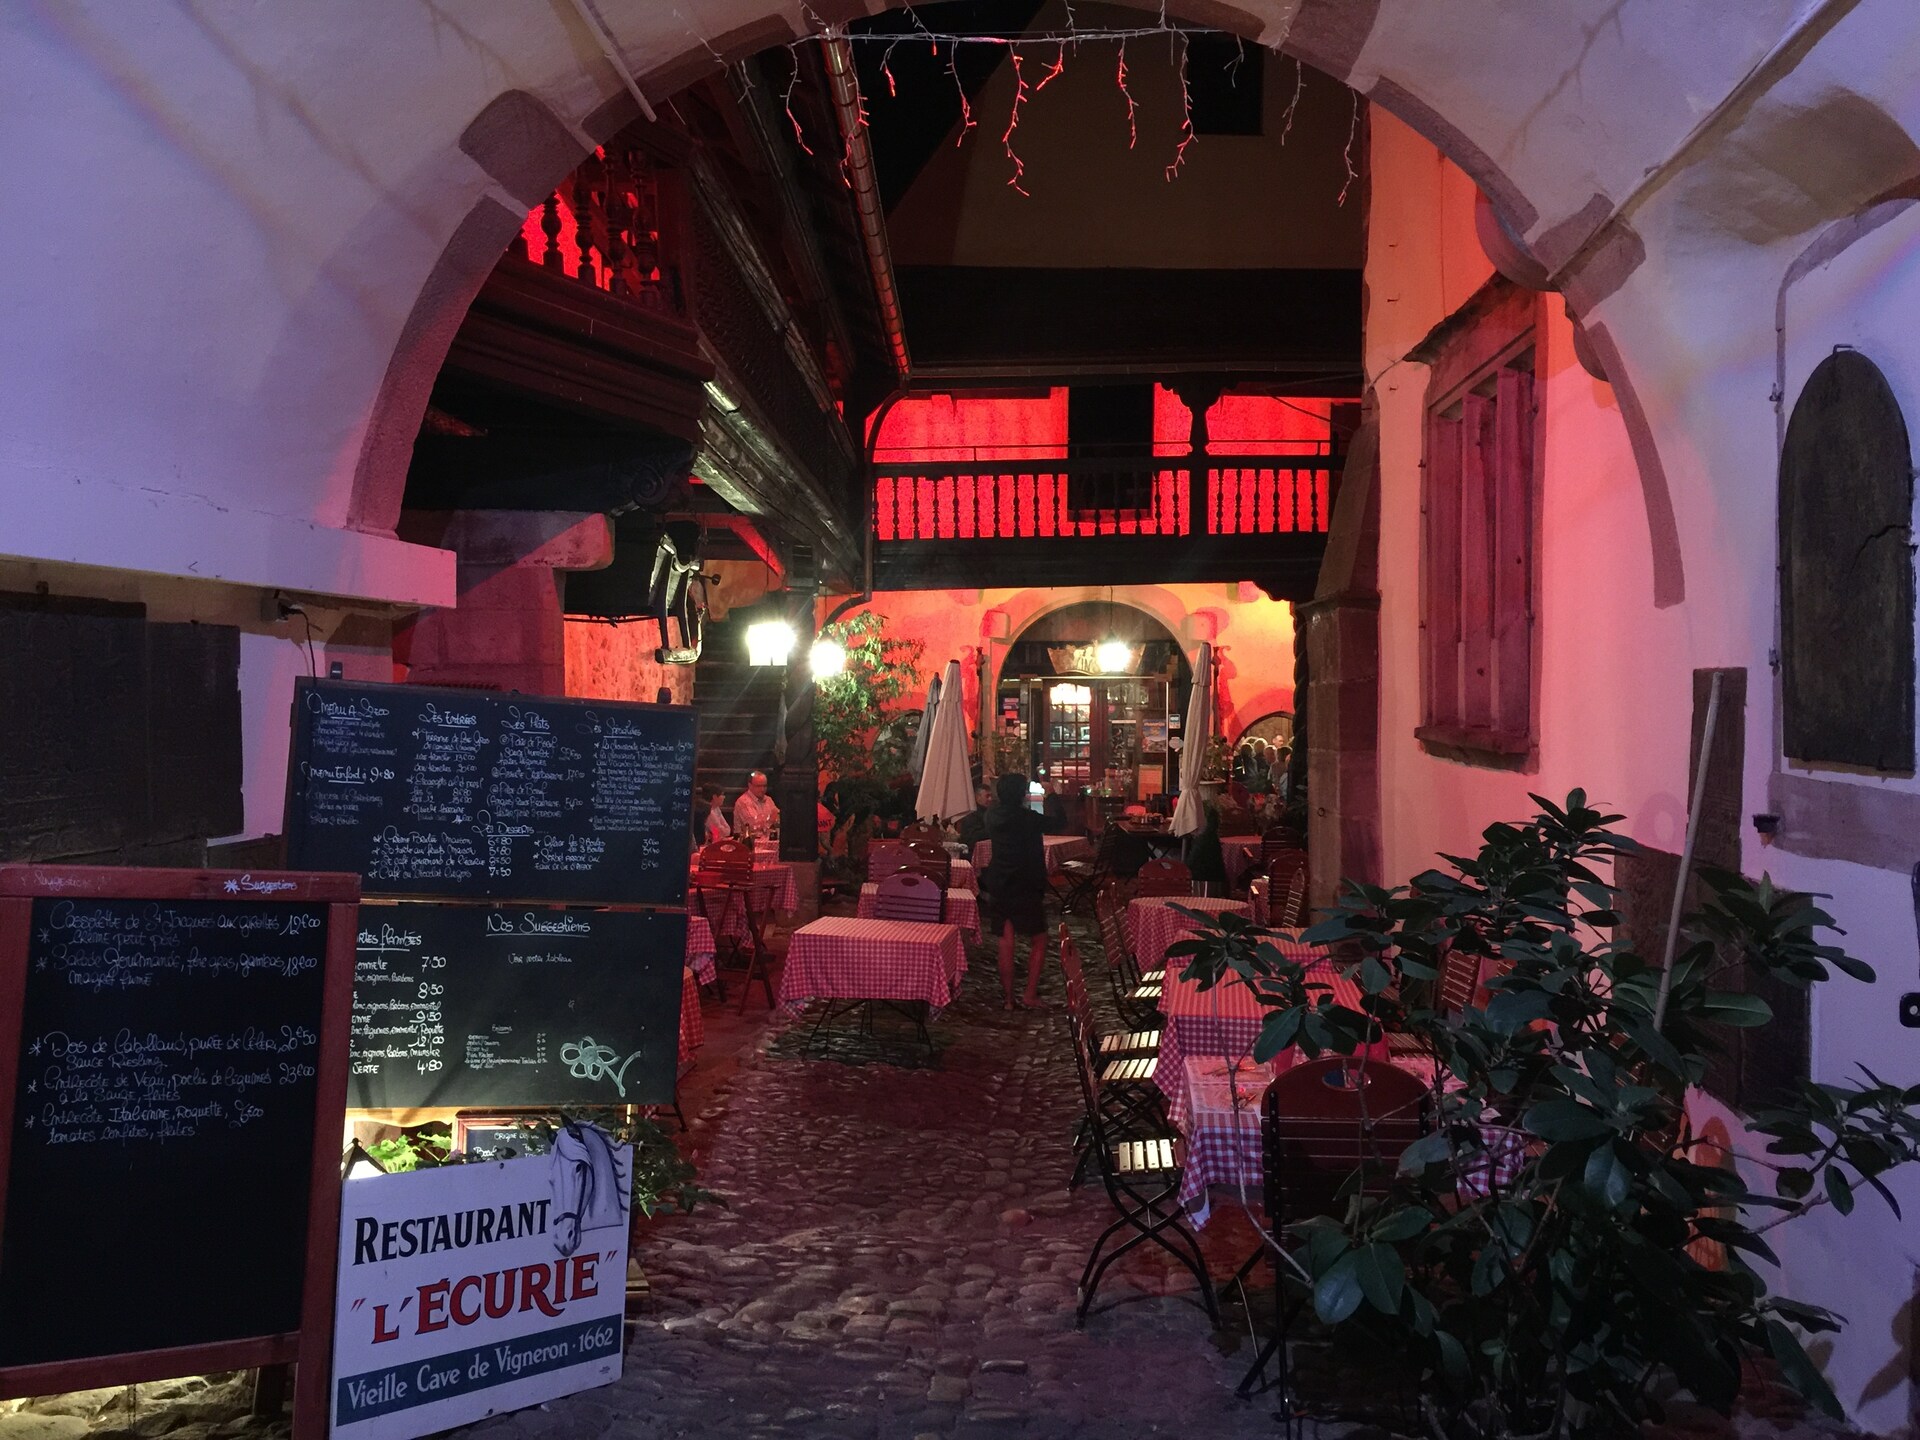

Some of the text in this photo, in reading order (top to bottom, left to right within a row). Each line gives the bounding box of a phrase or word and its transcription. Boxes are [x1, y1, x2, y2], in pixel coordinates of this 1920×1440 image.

[352, 1199, 552, 1266] RESTAURANT
[347, 1327, 614, 1411] Vieille Cave de Vigneron 1662
